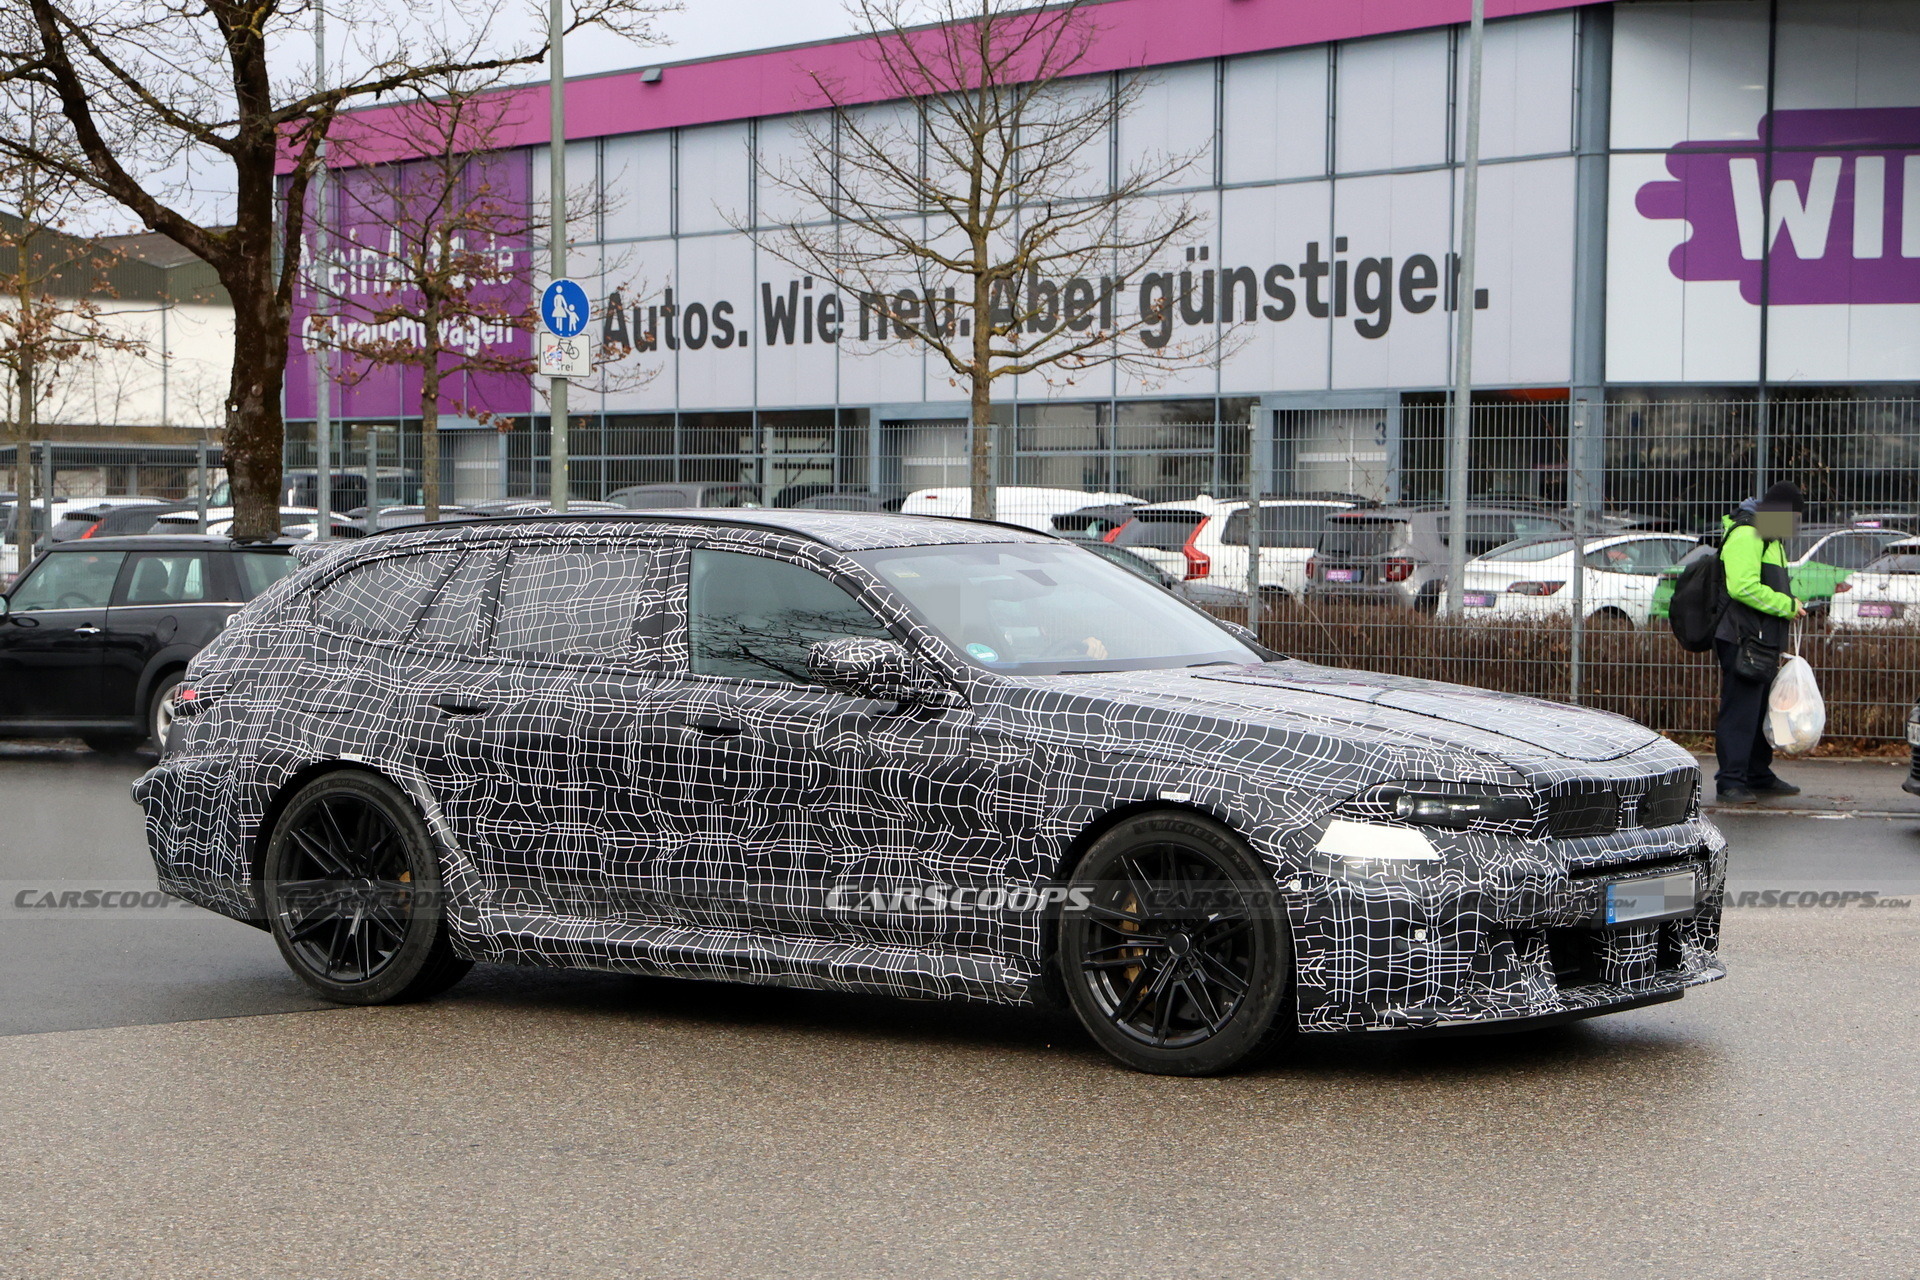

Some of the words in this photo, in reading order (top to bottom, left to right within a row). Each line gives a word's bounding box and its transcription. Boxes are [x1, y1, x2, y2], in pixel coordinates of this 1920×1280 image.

[603, 288, 748, 352] Autos.
[761, 276, 844, 346] Wie
[859, 287, 971, 342] neu.
[988, 262, 1125, 334] Aber
[1139, 236, 1489, 349] günstiger.
[302, 309, 513, 358] Gbrauchtwagen
[557, 363, 574, 372] rei
[1375, 421, 1387, 446] 3
[1155, 820, 1228, 850] MICHELIN
